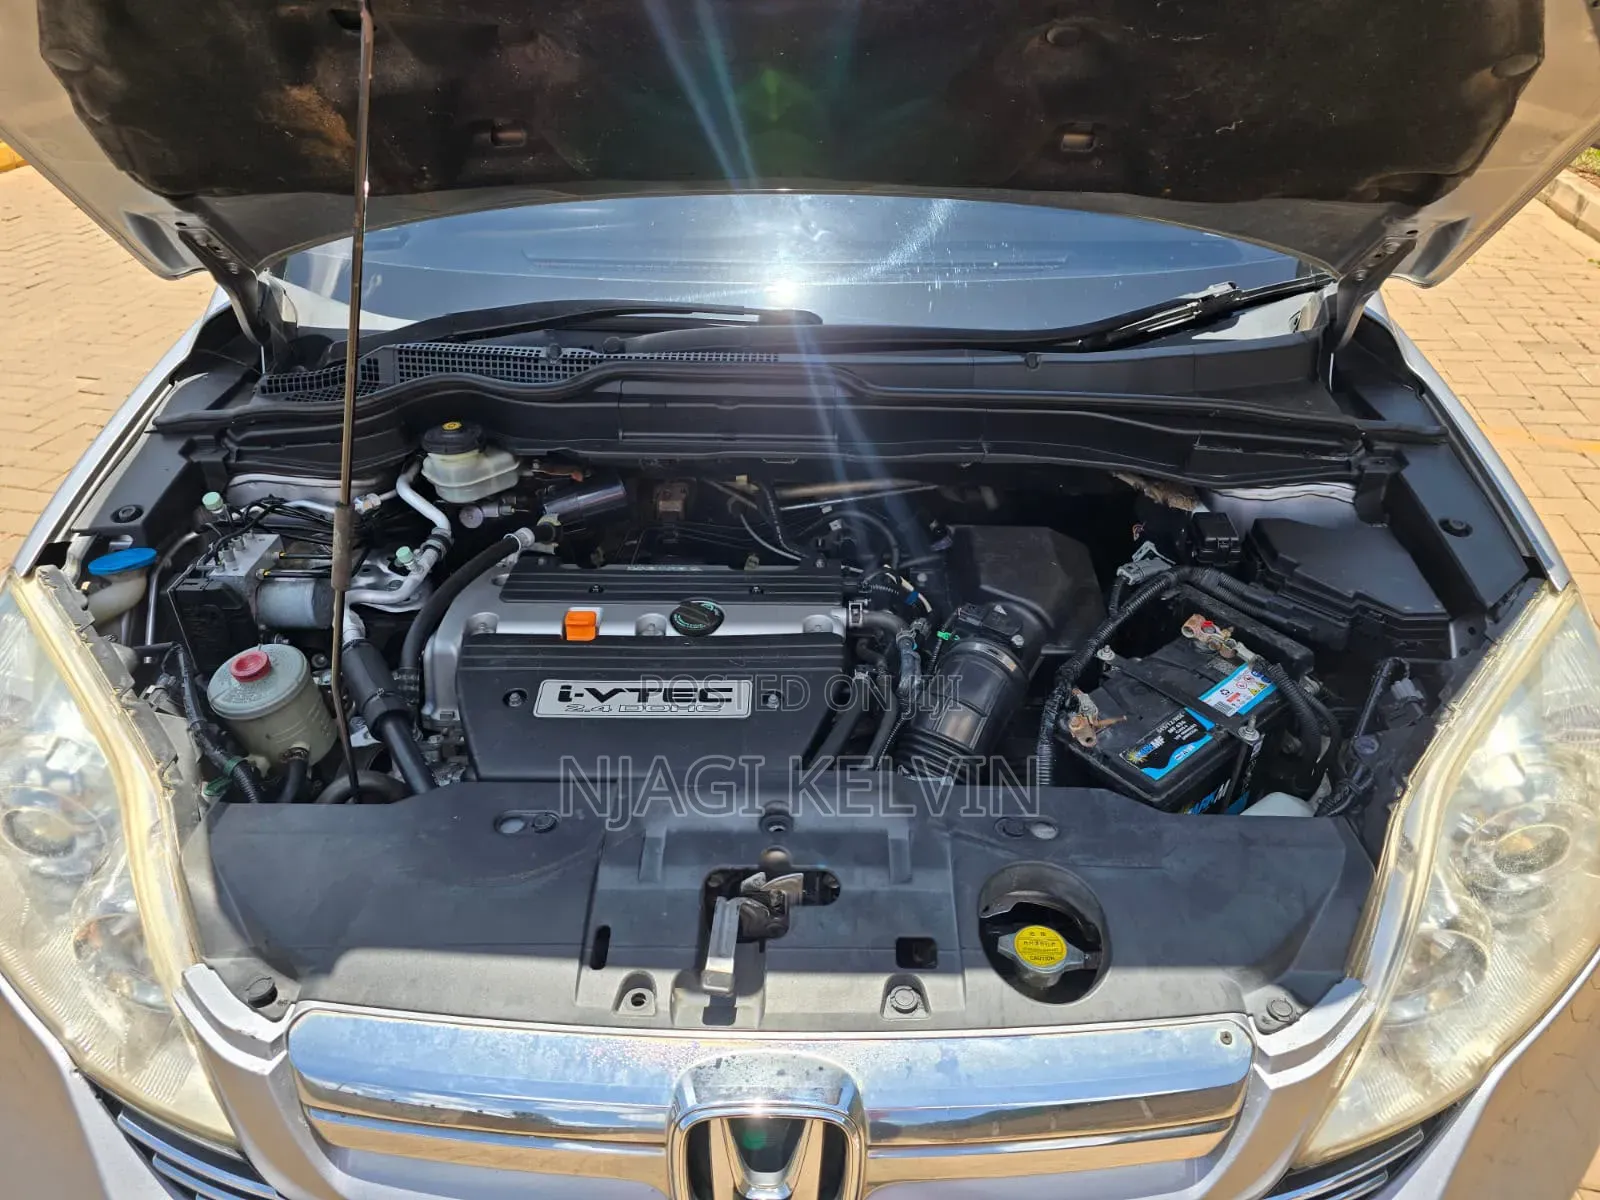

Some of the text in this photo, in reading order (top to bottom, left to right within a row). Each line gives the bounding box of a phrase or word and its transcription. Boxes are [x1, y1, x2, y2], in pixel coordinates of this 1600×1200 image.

[558, 685, 733, 703] i-VTEC
[564, 703, 722, 713] 2.4 DOHC
